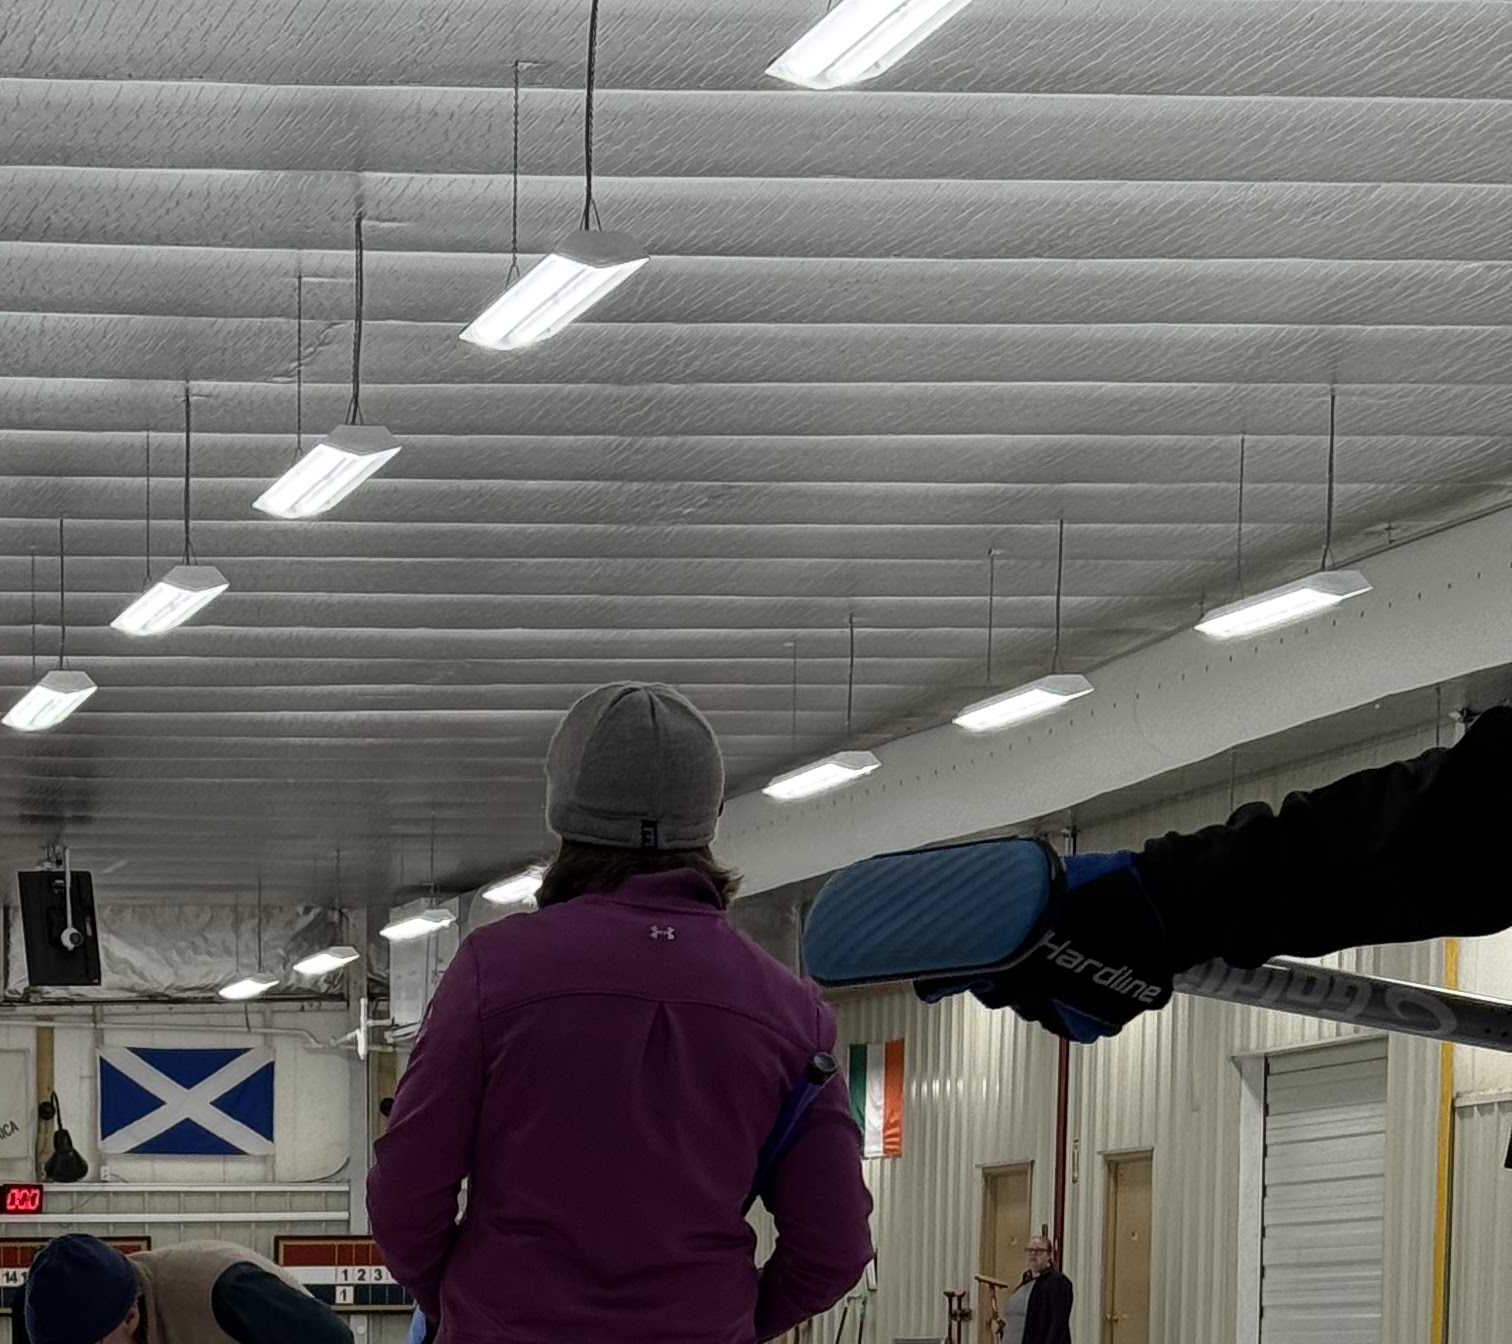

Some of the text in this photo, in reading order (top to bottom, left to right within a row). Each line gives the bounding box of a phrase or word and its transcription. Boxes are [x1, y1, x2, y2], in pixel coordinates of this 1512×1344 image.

[1038, 929, 1162, 1004] Hardline
[3, 1271, 18, 1284] 14
[341, 1268, 383, 1281] 1 2 3
[340, 1289, 347, 1302] 1
